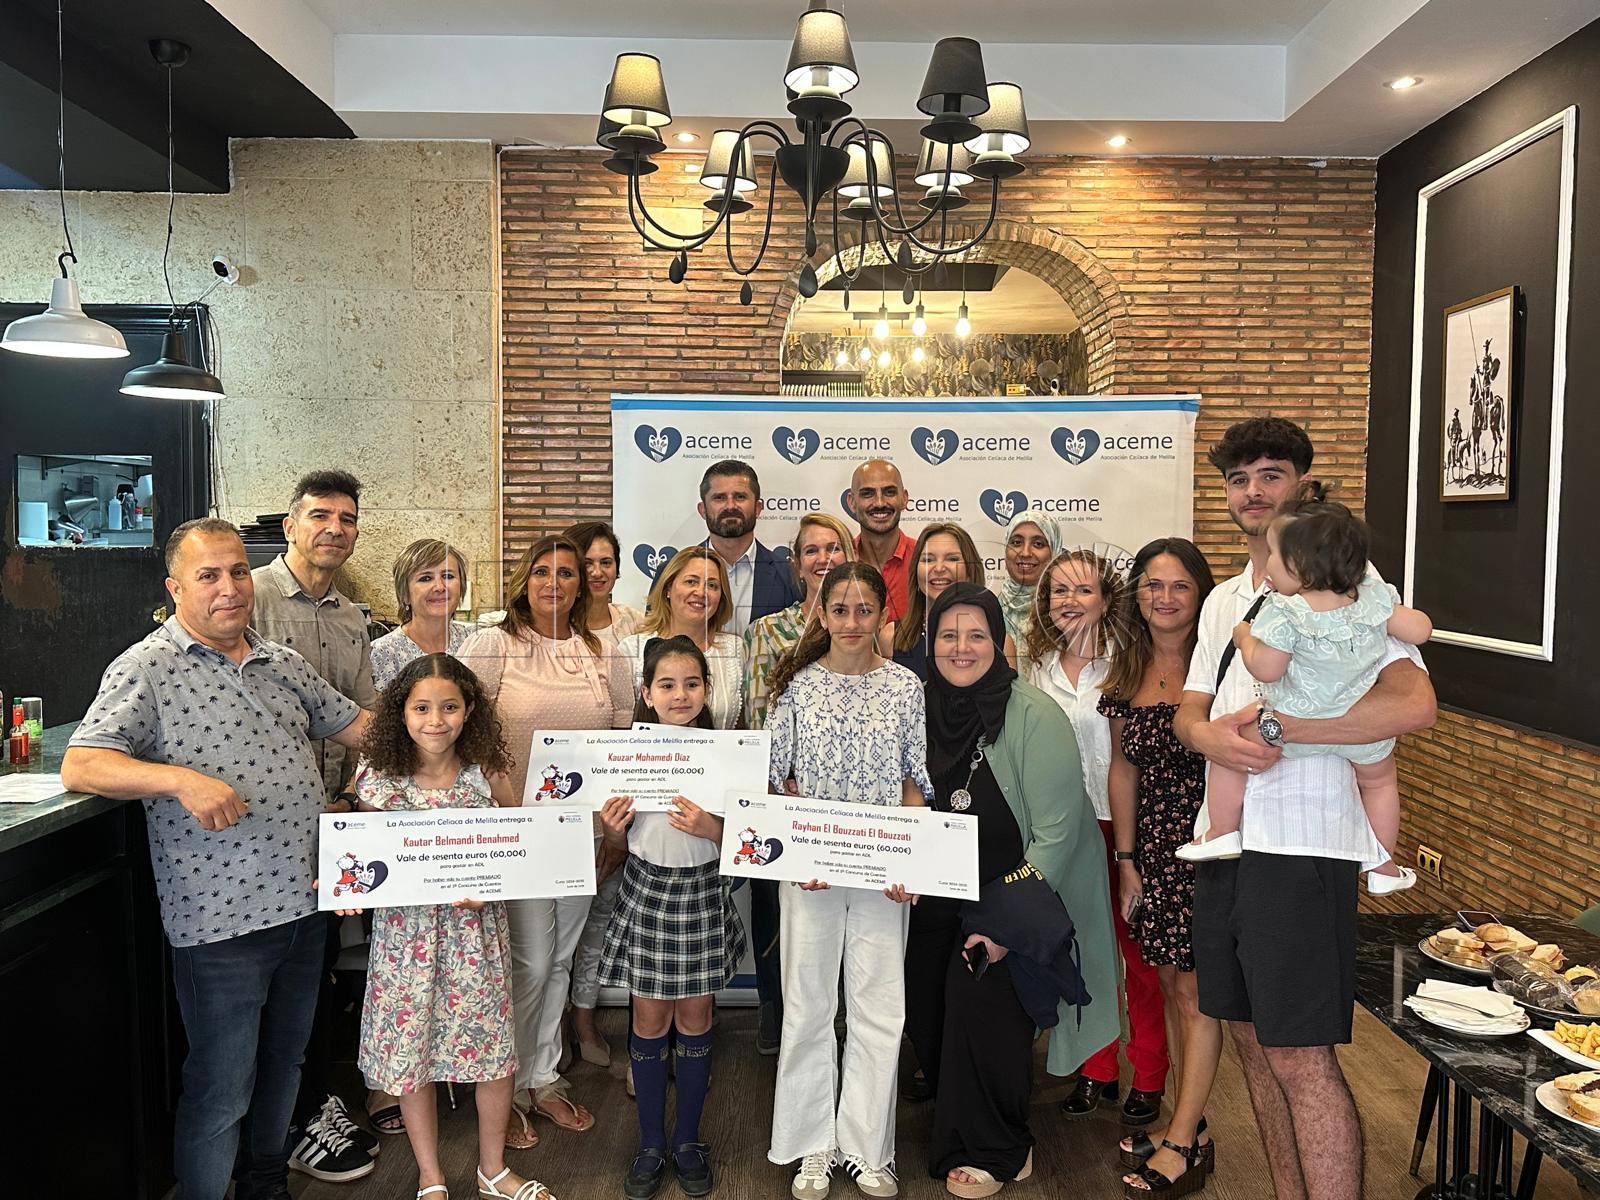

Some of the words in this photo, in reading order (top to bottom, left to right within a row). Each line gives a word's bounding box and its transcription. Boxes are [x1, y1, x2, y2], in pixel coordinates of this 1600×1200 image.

[685, 435, 752, 450] aceme
[823, 436, 890, 450] aceme
[962, 436, 1030, 451] aceme
[1103, 435, 1174, 450] aceme
[905, 499, 960, 512] ceme
[1032, 498, 1100, 512] aceme
[608, 752, 634, 761] Kauzar
[635, 752, 672, 761] Mohamedi
[795, 805, 828, 815] Asociación
[792, 820, 821, 833] Rayhan
[824, 824, 830, 833] El
[833, 824, 866, 837] Bouzzati
[868, 828, 876, 838] El
[878, 829, 911, 842] Bouzzati
[403, 836, 432, 847] Kautar
[435, 834, 474, 846] Belmandi
[477, 833, 520, 844] Benahmed
[791, 835, 810, 844] Vale
[811, 837, 822, 845] de
[823, 839, 852, 848] sesenta
[396, 854, 416, 862] Vale
[418, 853, 430, 861] de
[432, 853, 463, 861] sesenta
[490, 849, 526, 860] (60,00€)
